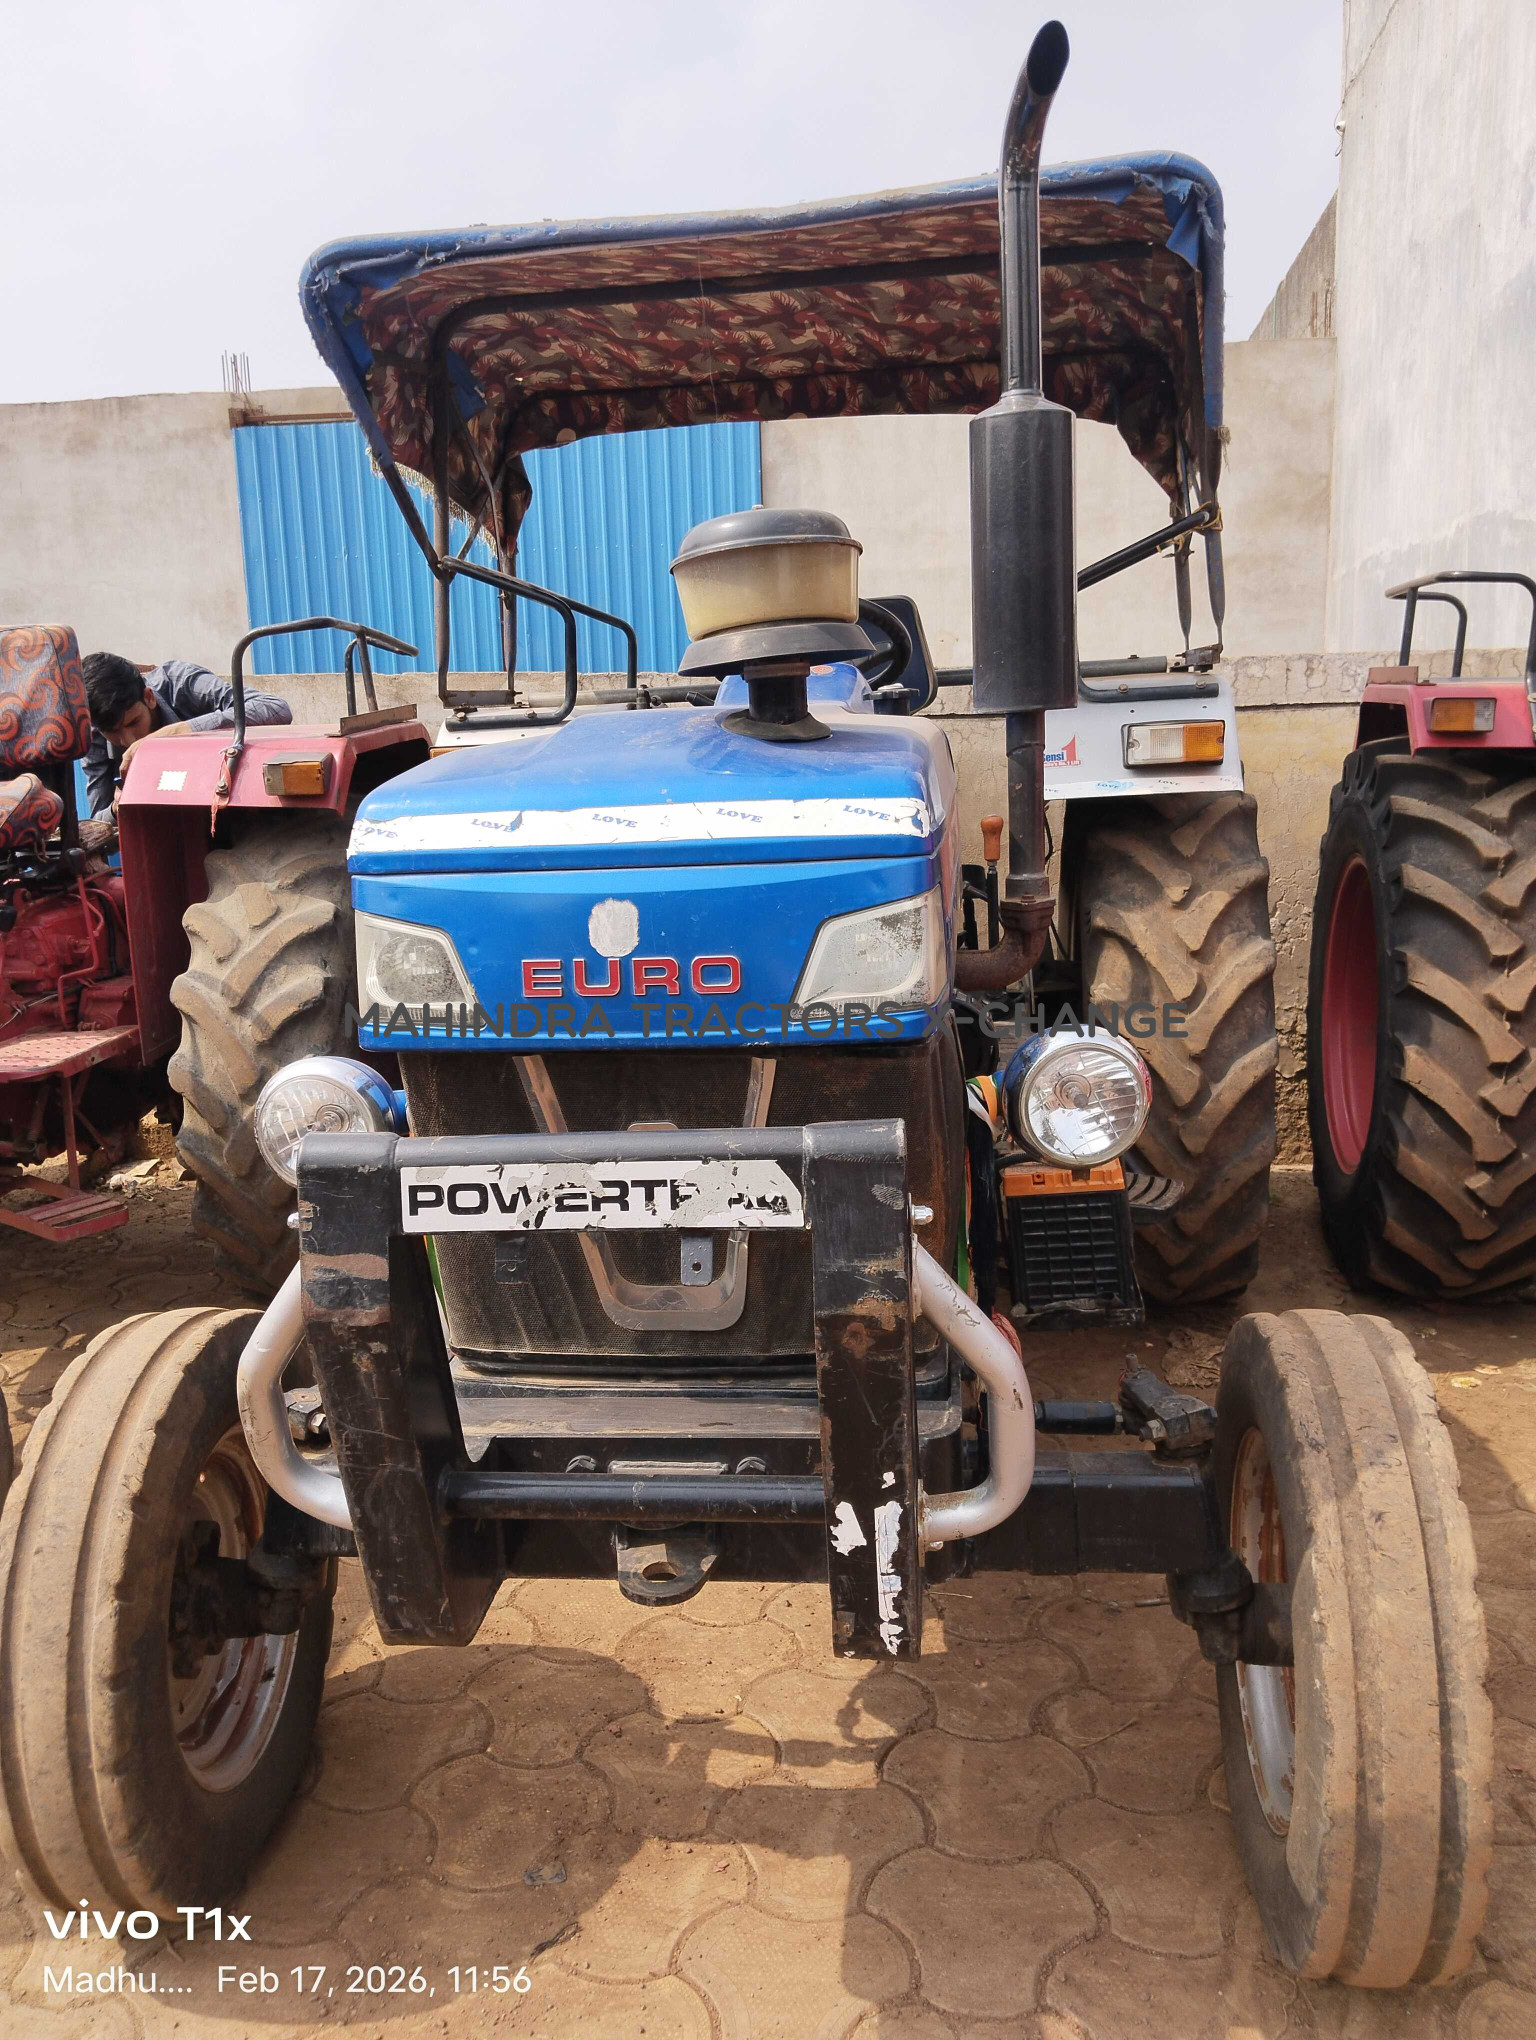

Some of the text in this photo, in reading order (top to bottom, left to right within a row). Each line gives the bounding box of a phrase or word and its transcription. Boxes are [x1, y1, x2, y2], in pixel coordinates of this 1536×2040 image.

[1043, 751, 1065, 762] ensi
[1097, 782, 1120, 790] LOVE
[1158, 778, 1181, 787] LOVE
[471, 818, 514, 833] LOVE
[592, 813, 638, 829] LOVE
[716, 807, 764, 823] LOVE
[843, 804, 891, 821] LOVE
[521, 955, 741, 998] EURO
